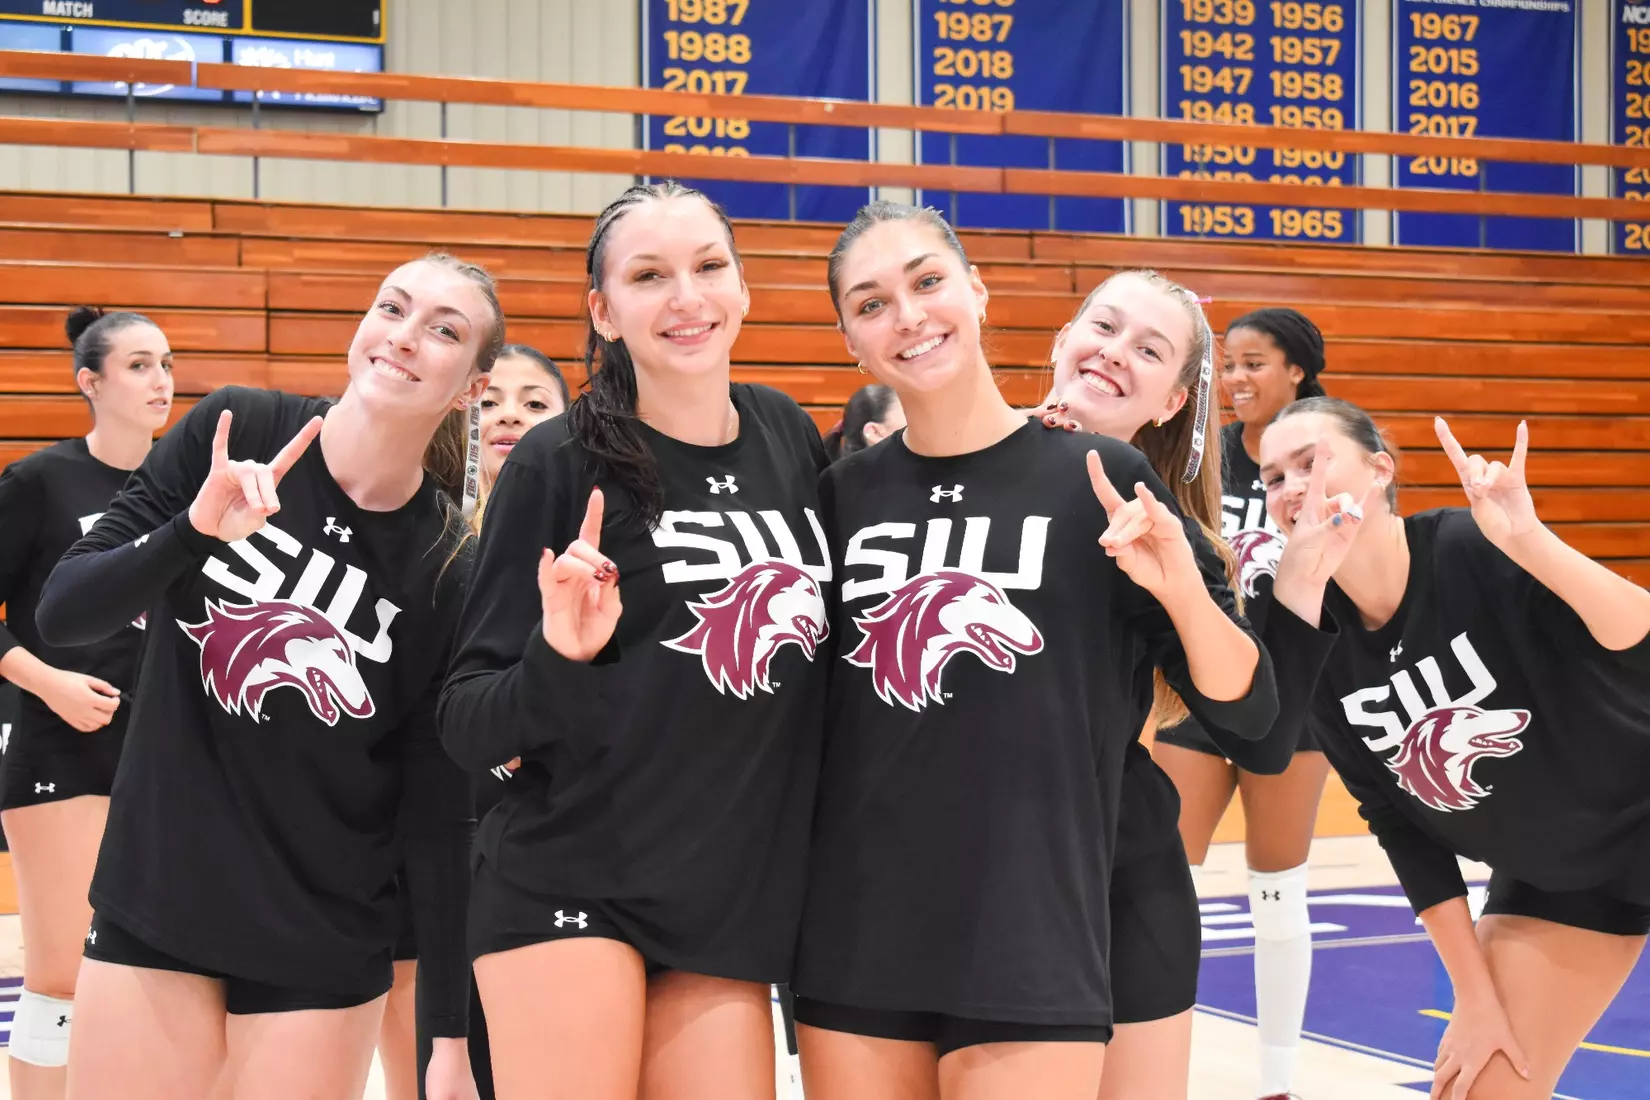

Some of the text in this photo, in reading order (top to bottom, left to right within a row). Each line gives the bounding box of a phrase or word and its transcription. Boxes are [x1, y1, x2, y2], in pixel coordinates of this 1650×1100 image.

[43, 0, 93, 18] MATCH
[183, 8, 229, 27] SCORE
[664, 0, 750, 25] 1987
[1180, 0, 1256, 26] 1939
[1269, 1, 1344, 32] 1956
[933, 11, 1013, 42] 1987
[1410, 12, 1480, 41] 1967
[663, 30, 751, 64] 1988
[1179, 30, 1255, 61] 1942
[1269, 36, 1341, 66] 1957
[933, 46, 1013, 79] 2018
[1409, 46, 1479, 76] 2015
[663, 67, 748, 96] 2017
[1179, 65, 1253, 95] 1947
[1269, 70, 1344, 101] 1958
[1409, 79, 1479, 110] 2016
[933, 83, 1014, 114] 2019
[1179, 100, 1255, 126] 1948
[664, 115, 751, 139] 2018
[1269, 105, 1344, 131] 1959
[1409, 113, 1478, 138] 2017
[1409, 156, 1479, 177] 2018
[1179, 205, 1255, 235] 1953
[1269, 208, 1344, 239] 1965
[651, 507, 833, 584] SIU
[842, 515, 1052, 602] SIU
[201, 521, 403, 663] SIU
[1340, 631, 1497, 752] SIU
